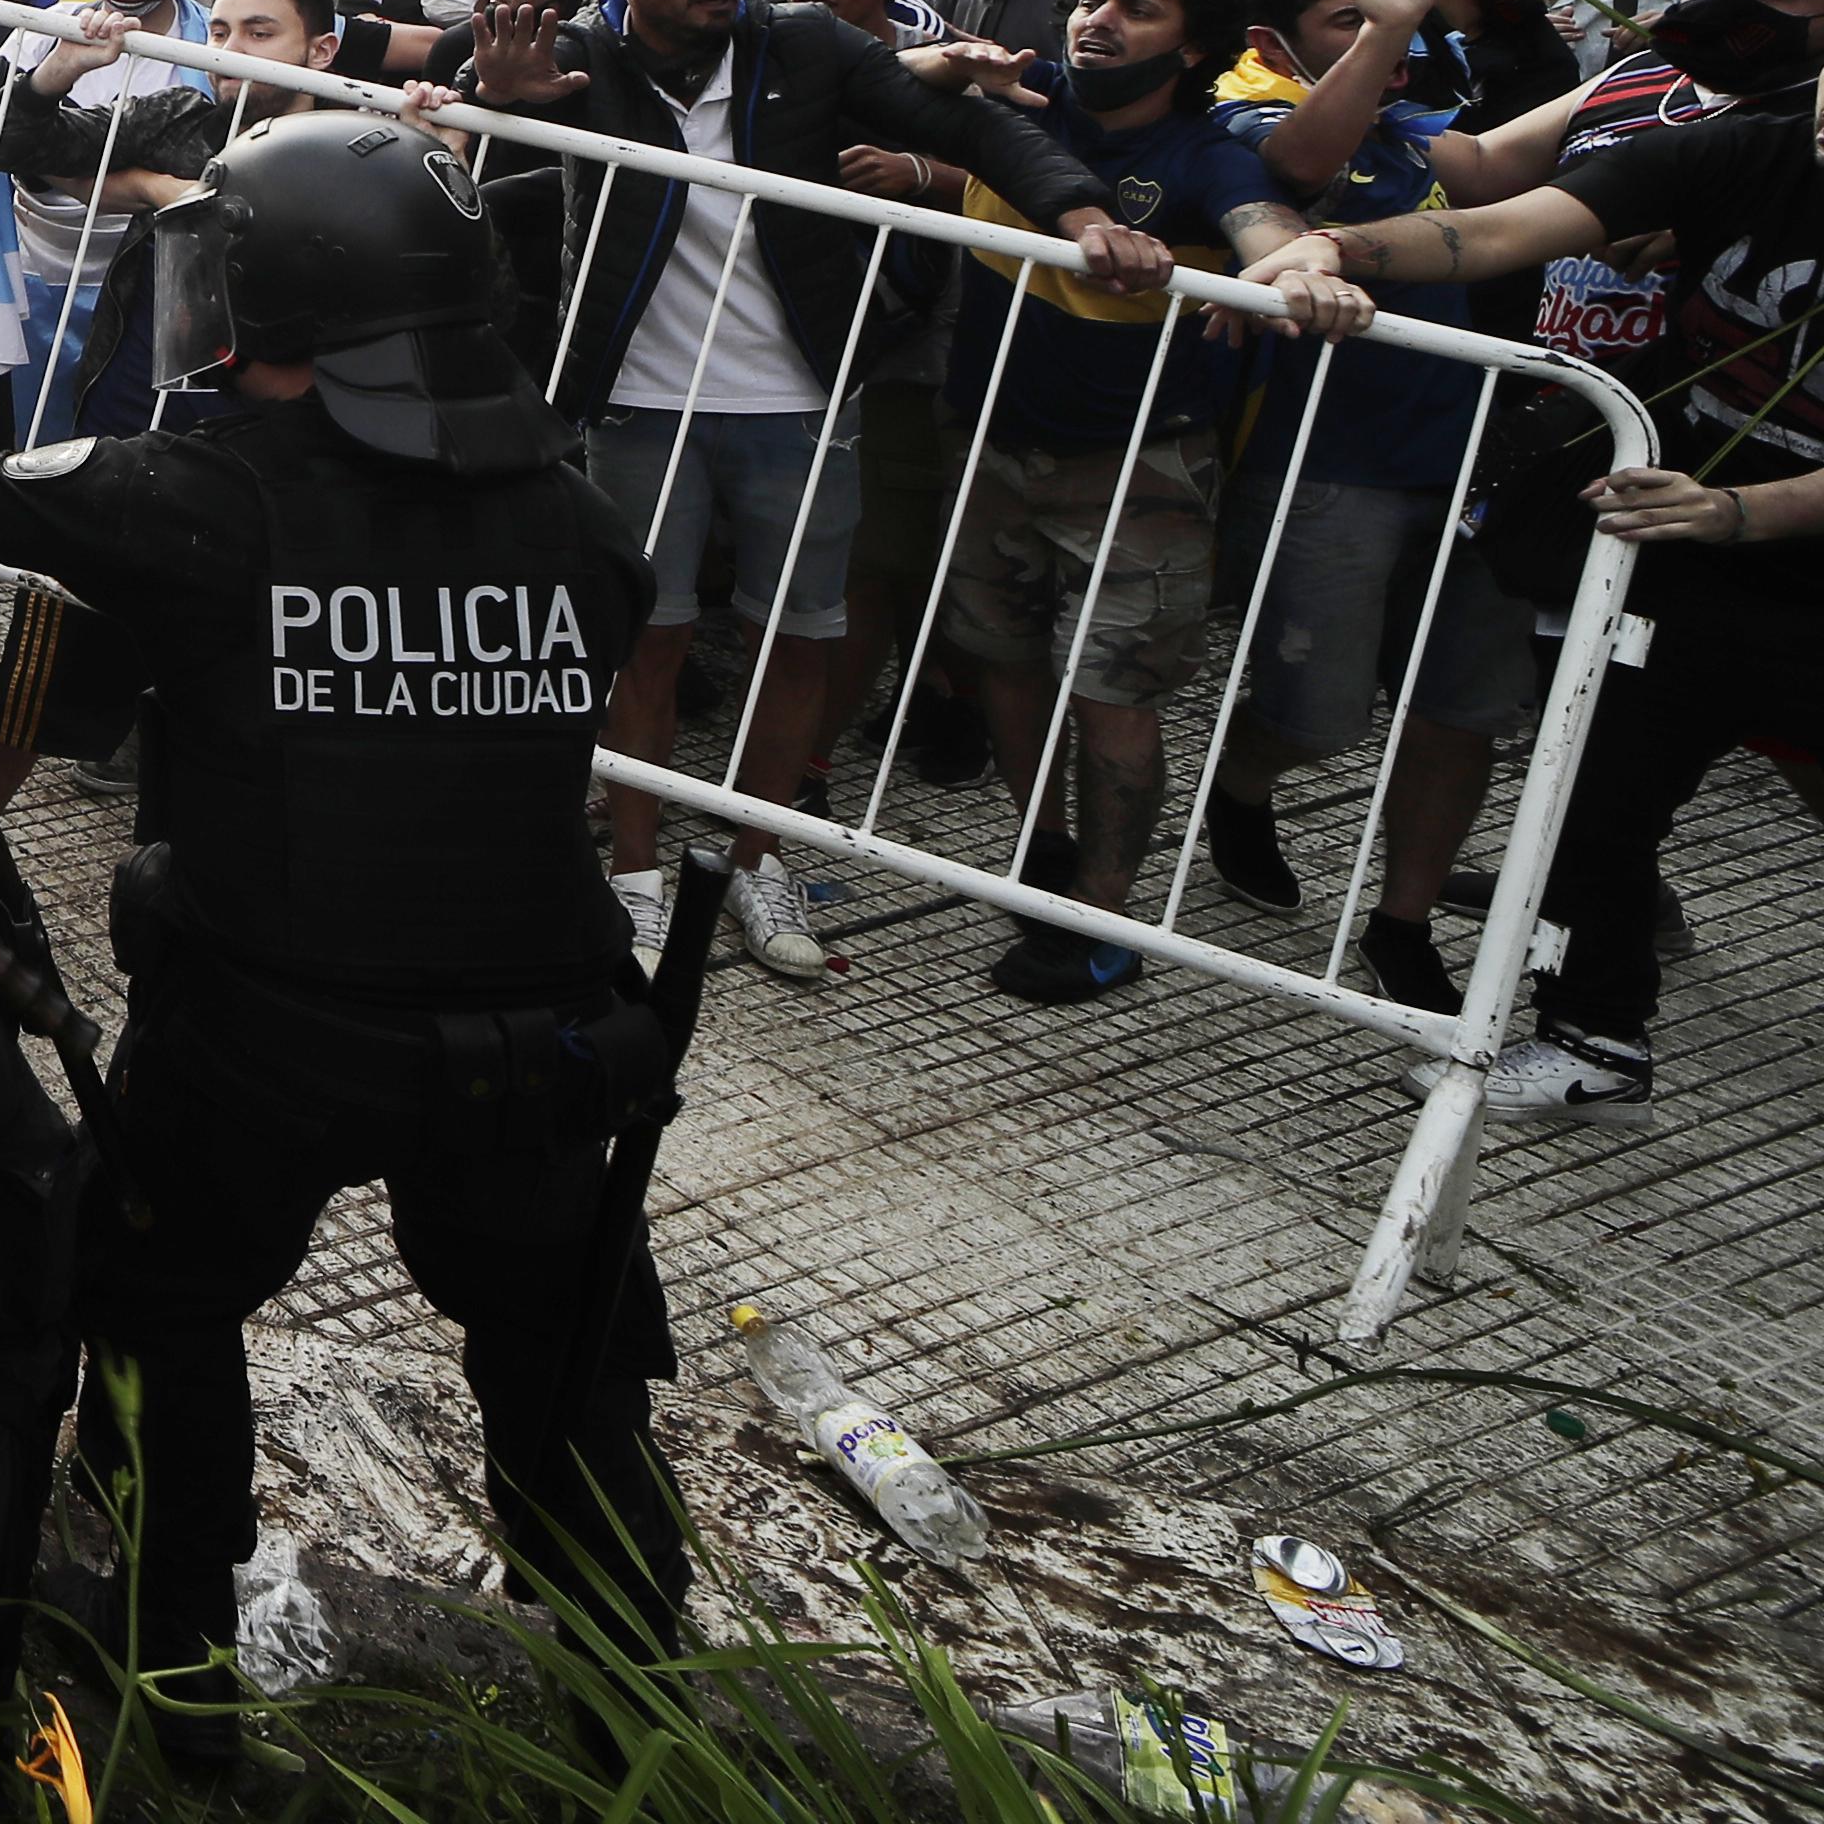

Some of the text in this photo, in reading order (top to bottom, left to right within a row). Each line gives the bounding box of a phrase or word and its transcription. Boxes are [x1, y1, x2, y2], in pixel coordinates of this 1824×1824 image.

[271, 584, 588, 663] POLICIA
[273, 666, 593, 717] DE LA CIUDAD
